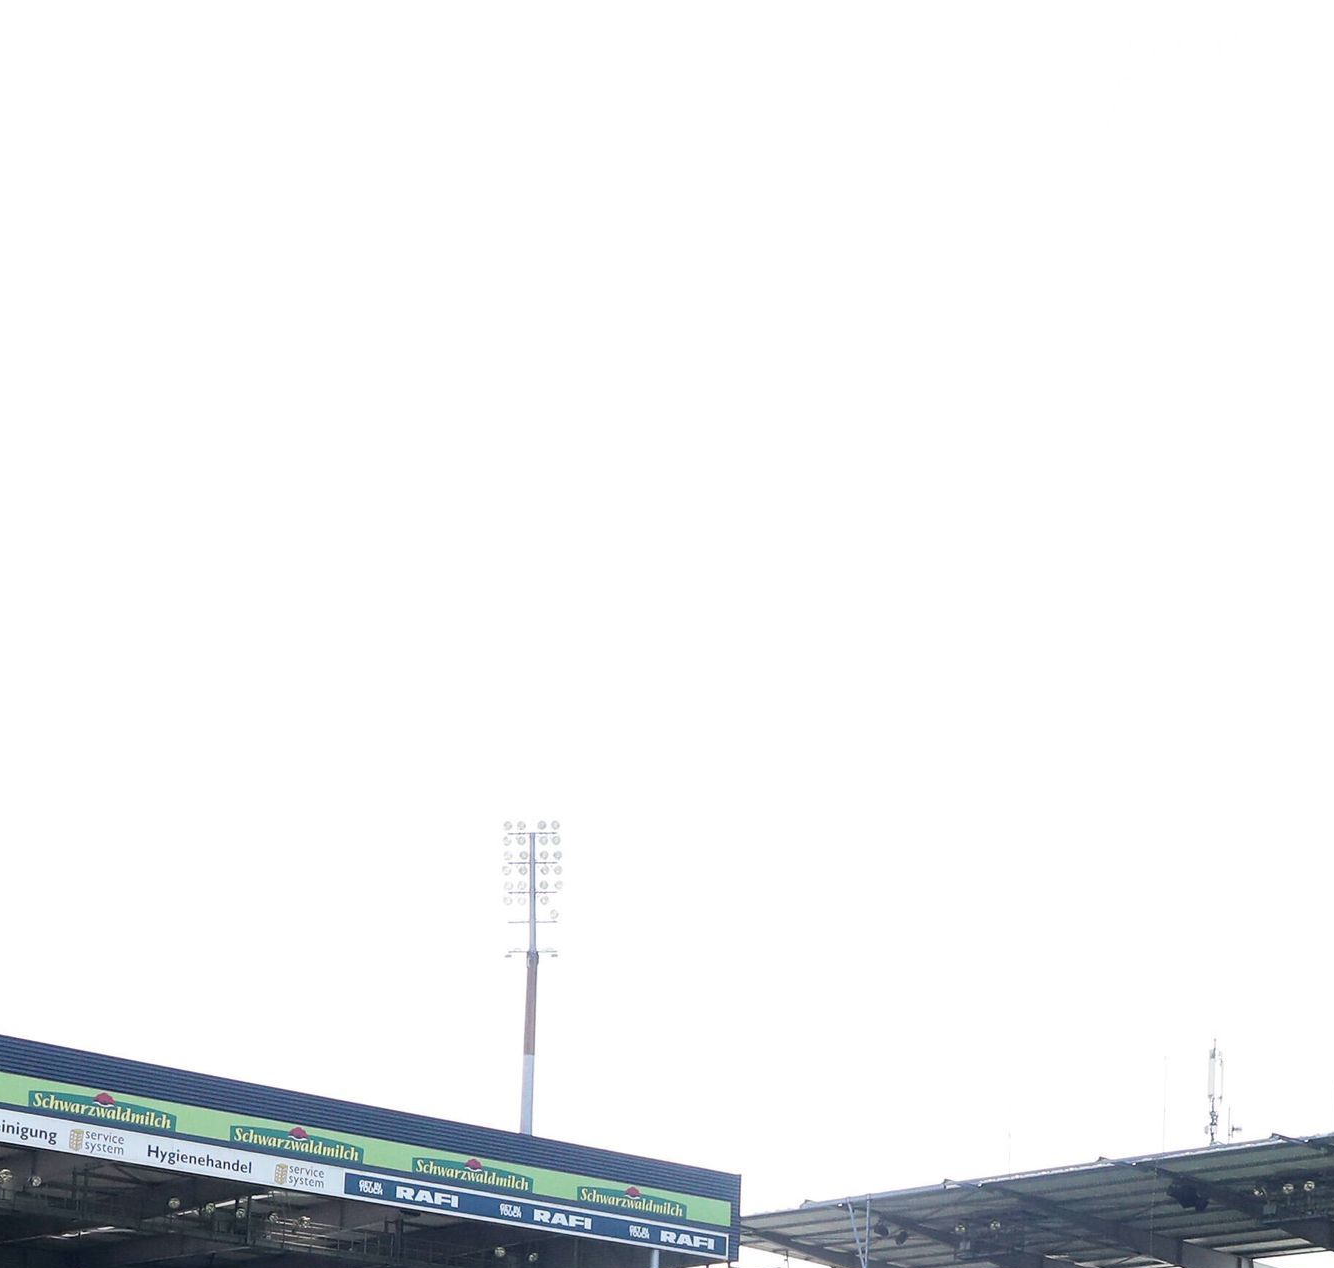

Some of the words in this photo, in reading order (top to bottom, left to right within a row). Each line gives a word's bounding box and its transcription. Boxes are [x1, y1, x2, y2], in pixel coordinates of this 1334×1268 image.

[33, 1092, 171, 1129] Schwarzwaldmilch
[84, 1140, 124, 1156] system
[85, 1129, 125, 1145] service
[233, 1128, 359, 1162] Schwarzwaldmilch
[147, 1144, 252, 1174] Hygienehandel
[288, 1175, 324, 1189] system
[289, 1164, 324, 1178] service
[416, 1159, 529, 1191] Schwarzwaldmilch
[396, 1186, 458, 1208] RAFI
[580, 1187, 683, 1217] Schwarzwaldmilch
[533, 1208, 592, 1230] RAFI
[660, 1230, 715, 1250] RAFI
